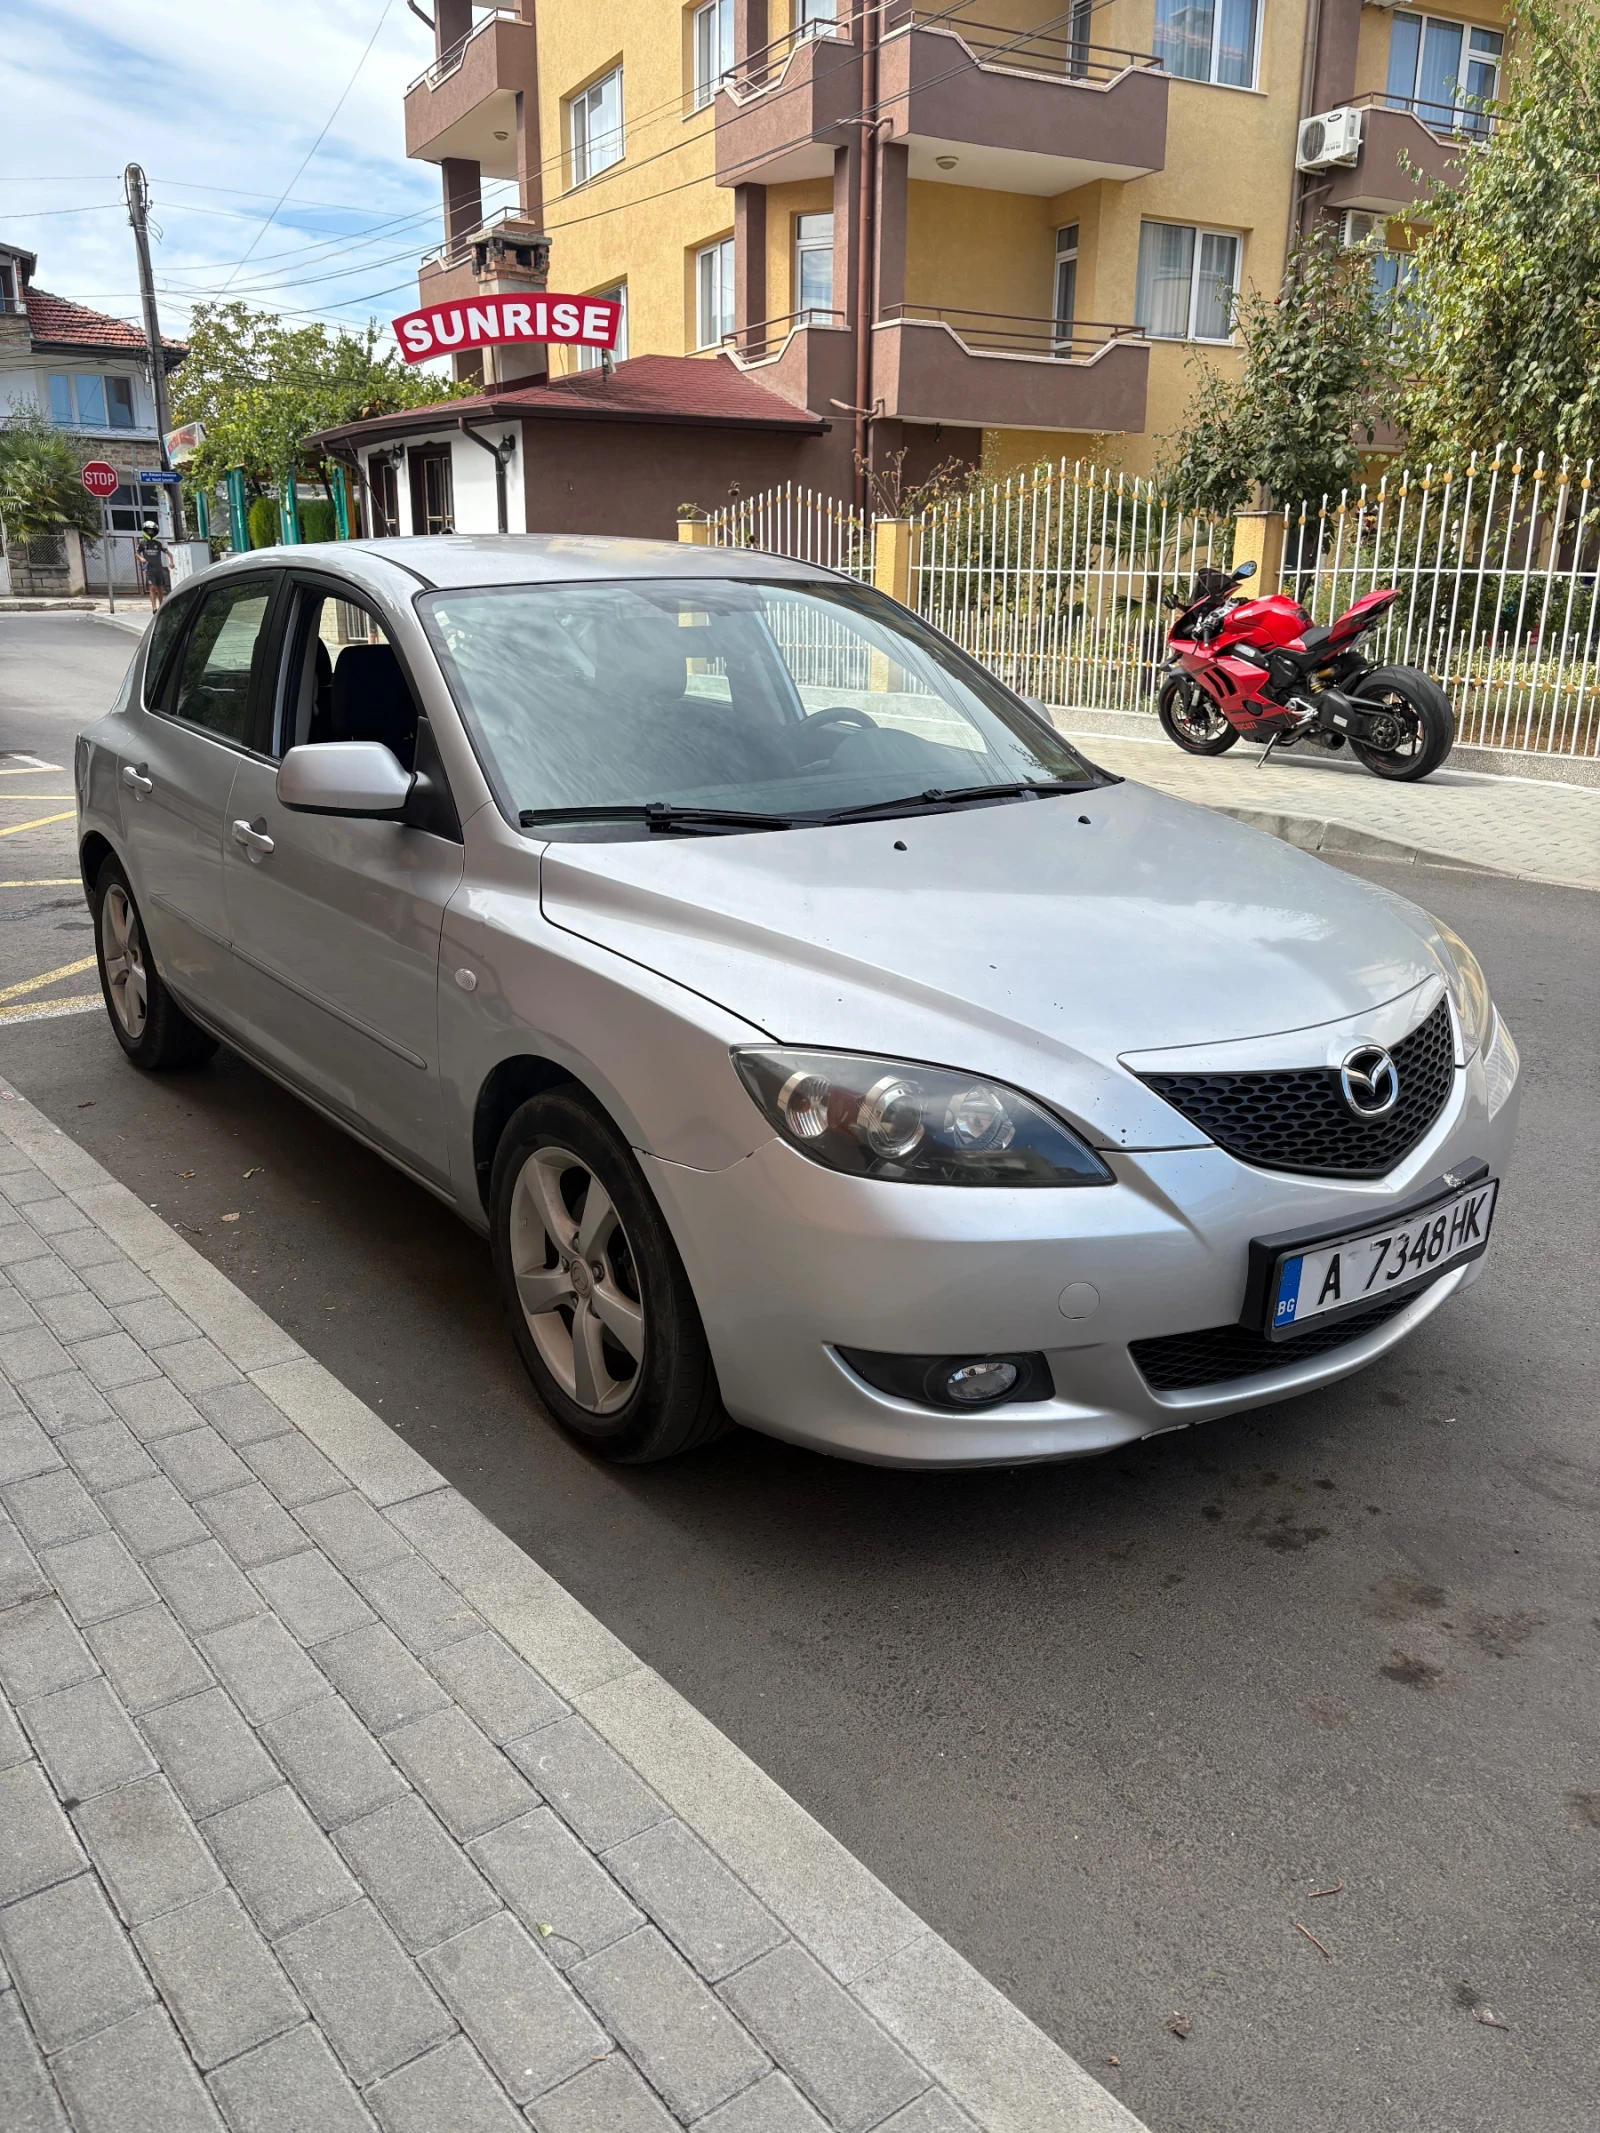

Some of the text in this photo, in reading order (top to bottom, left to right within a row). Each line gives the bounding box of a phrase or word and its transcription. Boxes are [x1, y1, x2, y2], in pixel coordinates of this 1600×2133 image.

[403, 302, 611, 353] SUNRISE
[84, 471, 115, 486] STOP
[1277, 1298, 1295, 1317] BG
